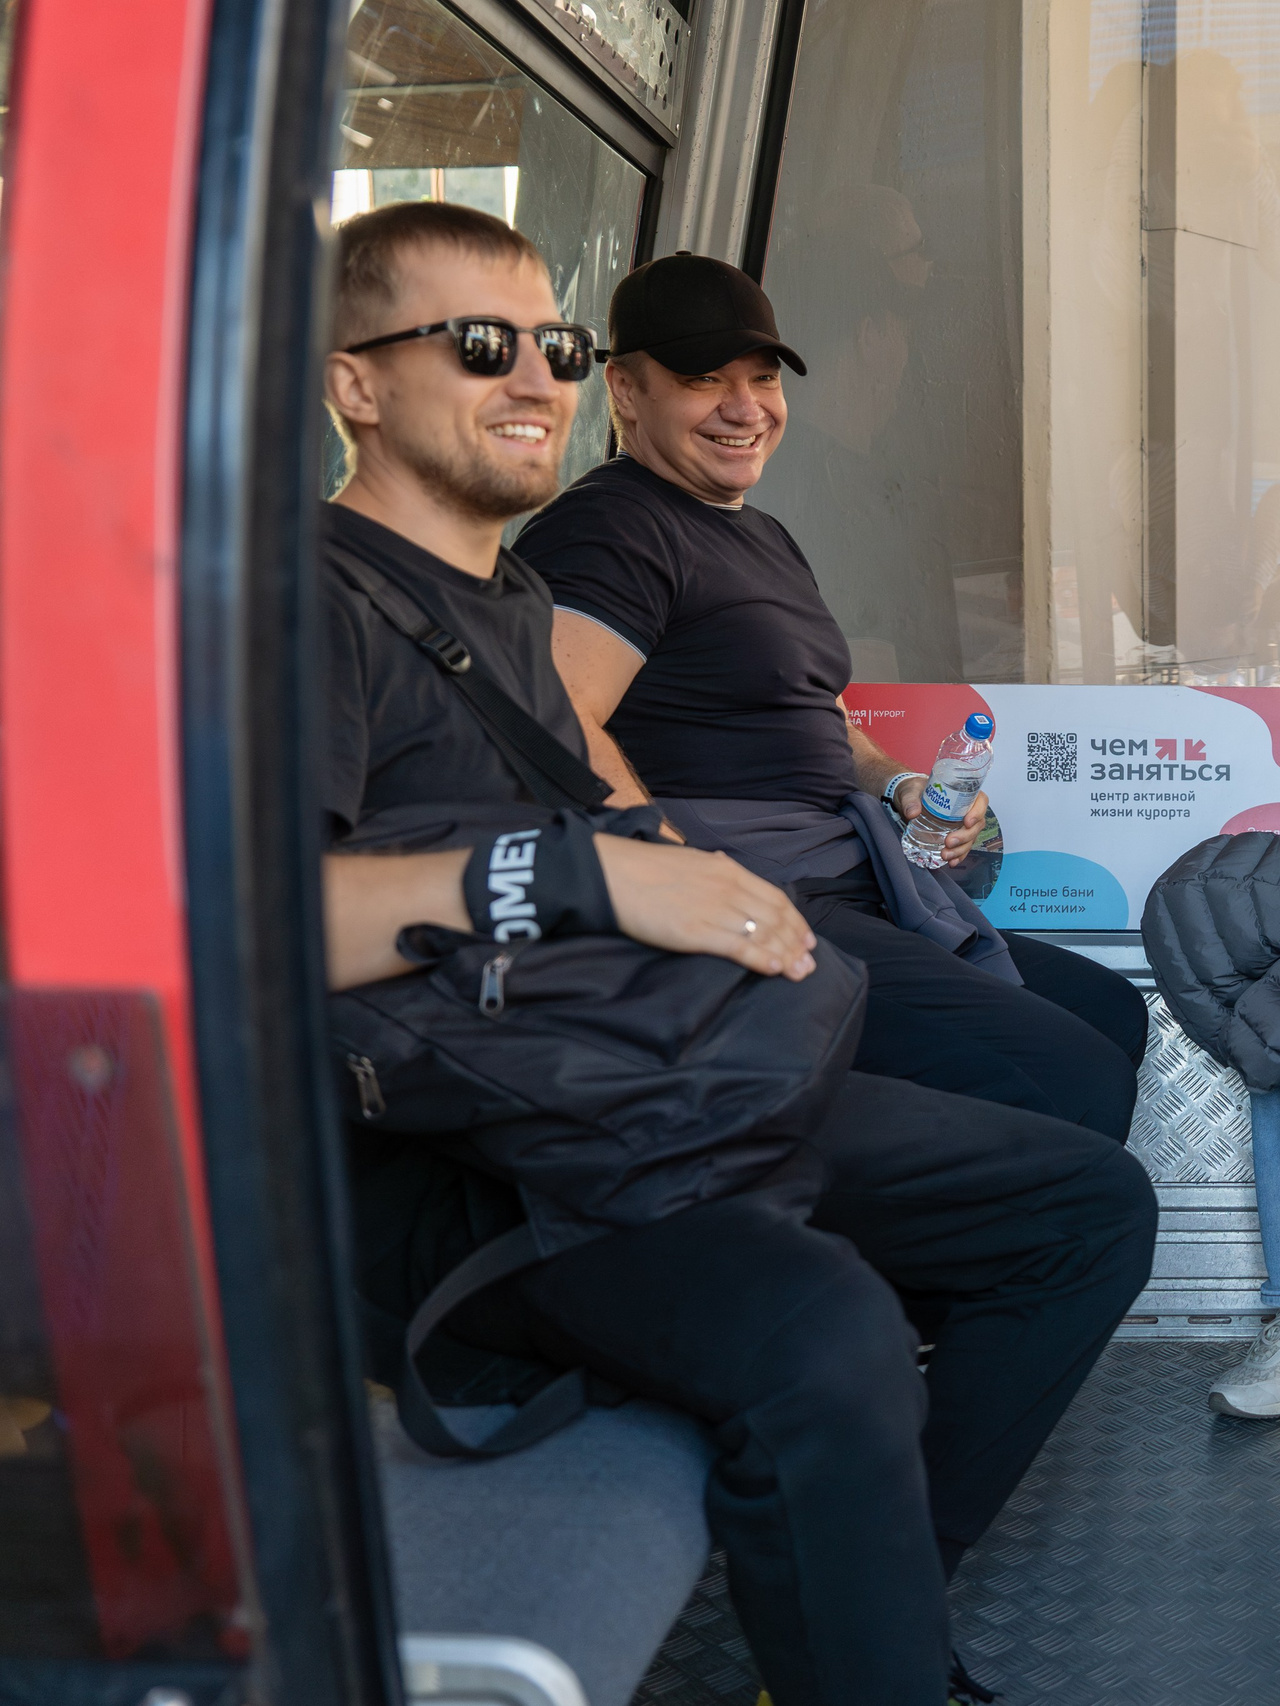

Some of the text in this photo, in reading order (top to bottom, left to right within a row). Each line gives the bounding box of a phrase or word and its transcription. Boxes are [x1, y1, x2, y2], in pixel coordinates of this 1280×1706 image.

[873, 710, 906, 718] КУРОРТ
[1090, 738, 1148, 756] чем
[1090, 763, 1231, 781] заняться
[1090, 790, 1196, 803] центр активной
[1090, 808, 1191, 820] жизни курорта
[1009, 886, 1094, 899] Горные бани
[1009, 902, 1086, 914] «4 стихии»
